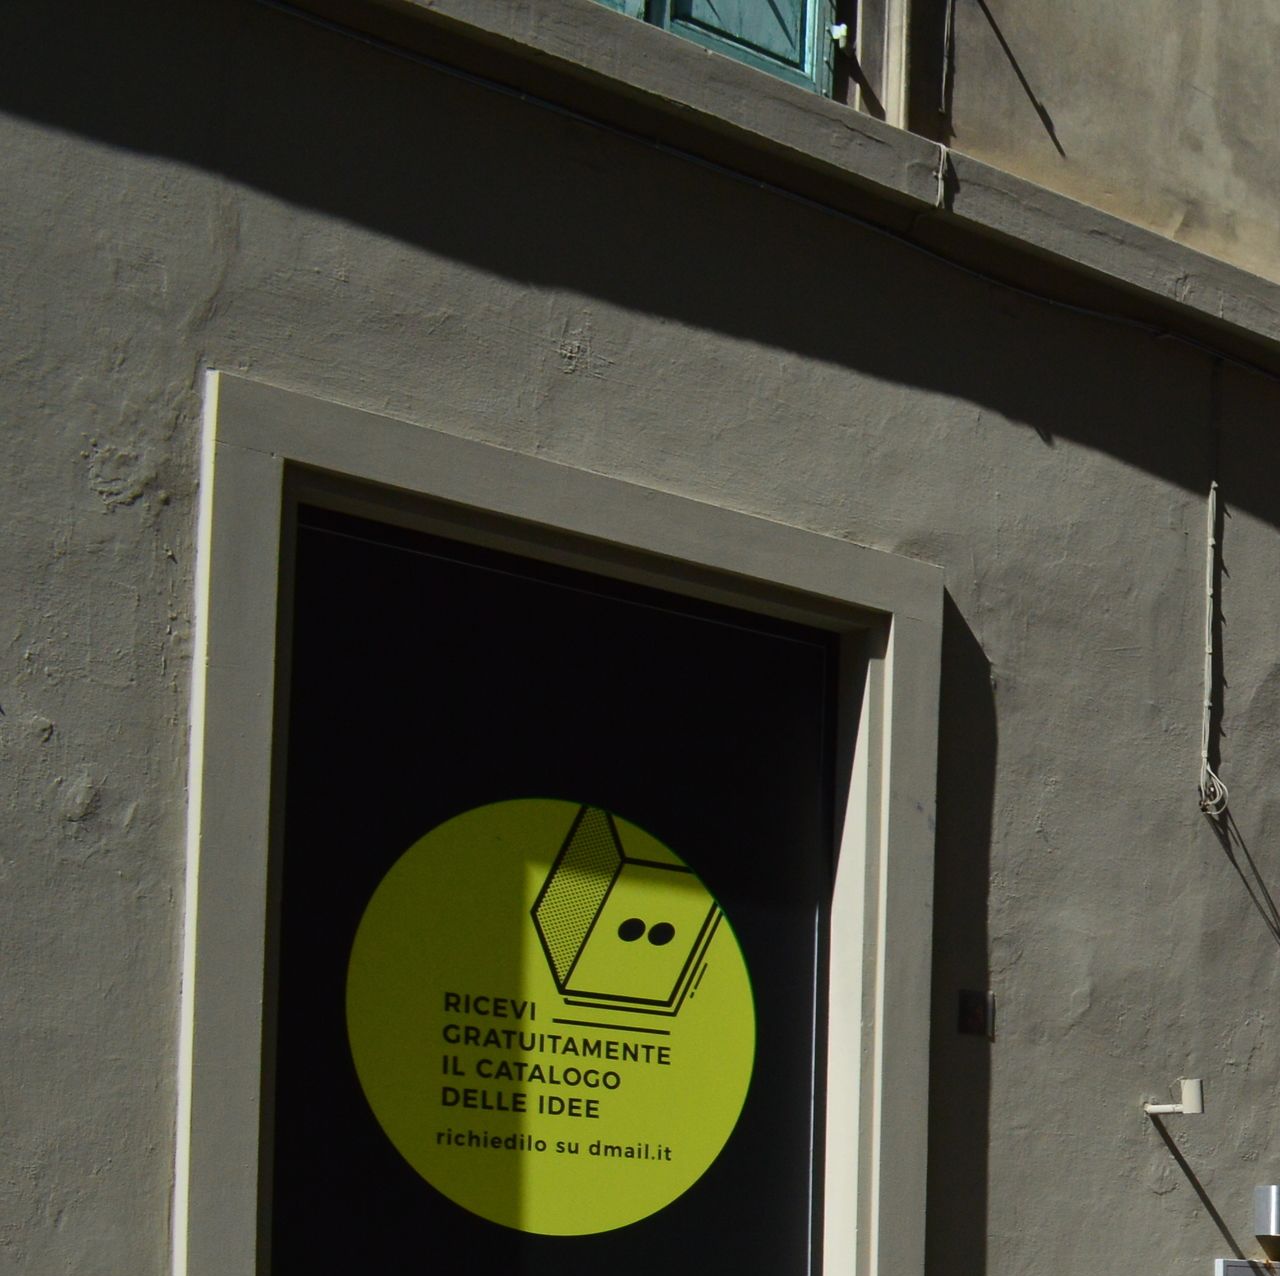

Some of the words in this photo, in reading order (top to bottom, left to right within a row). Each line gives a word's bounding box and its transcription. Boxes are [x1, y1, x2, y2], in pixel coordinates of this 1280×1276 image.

[444, 992, 537, 1021] RICEVI
[443, 1024, 671, 1065] GRATUITAMENTE
[442, 1055, 465, 1077] IL
[477, 1058, 621, 1090] CATALOGO
[442, 1087, 527, 1113] DELLE
[538, 1096, 600, 1119] IDEE
[436, 1128, 547, 1153] richiedilo
[556, 1138, 580, 1154] su
[589, 1139, 672, 1161] dmail.it
